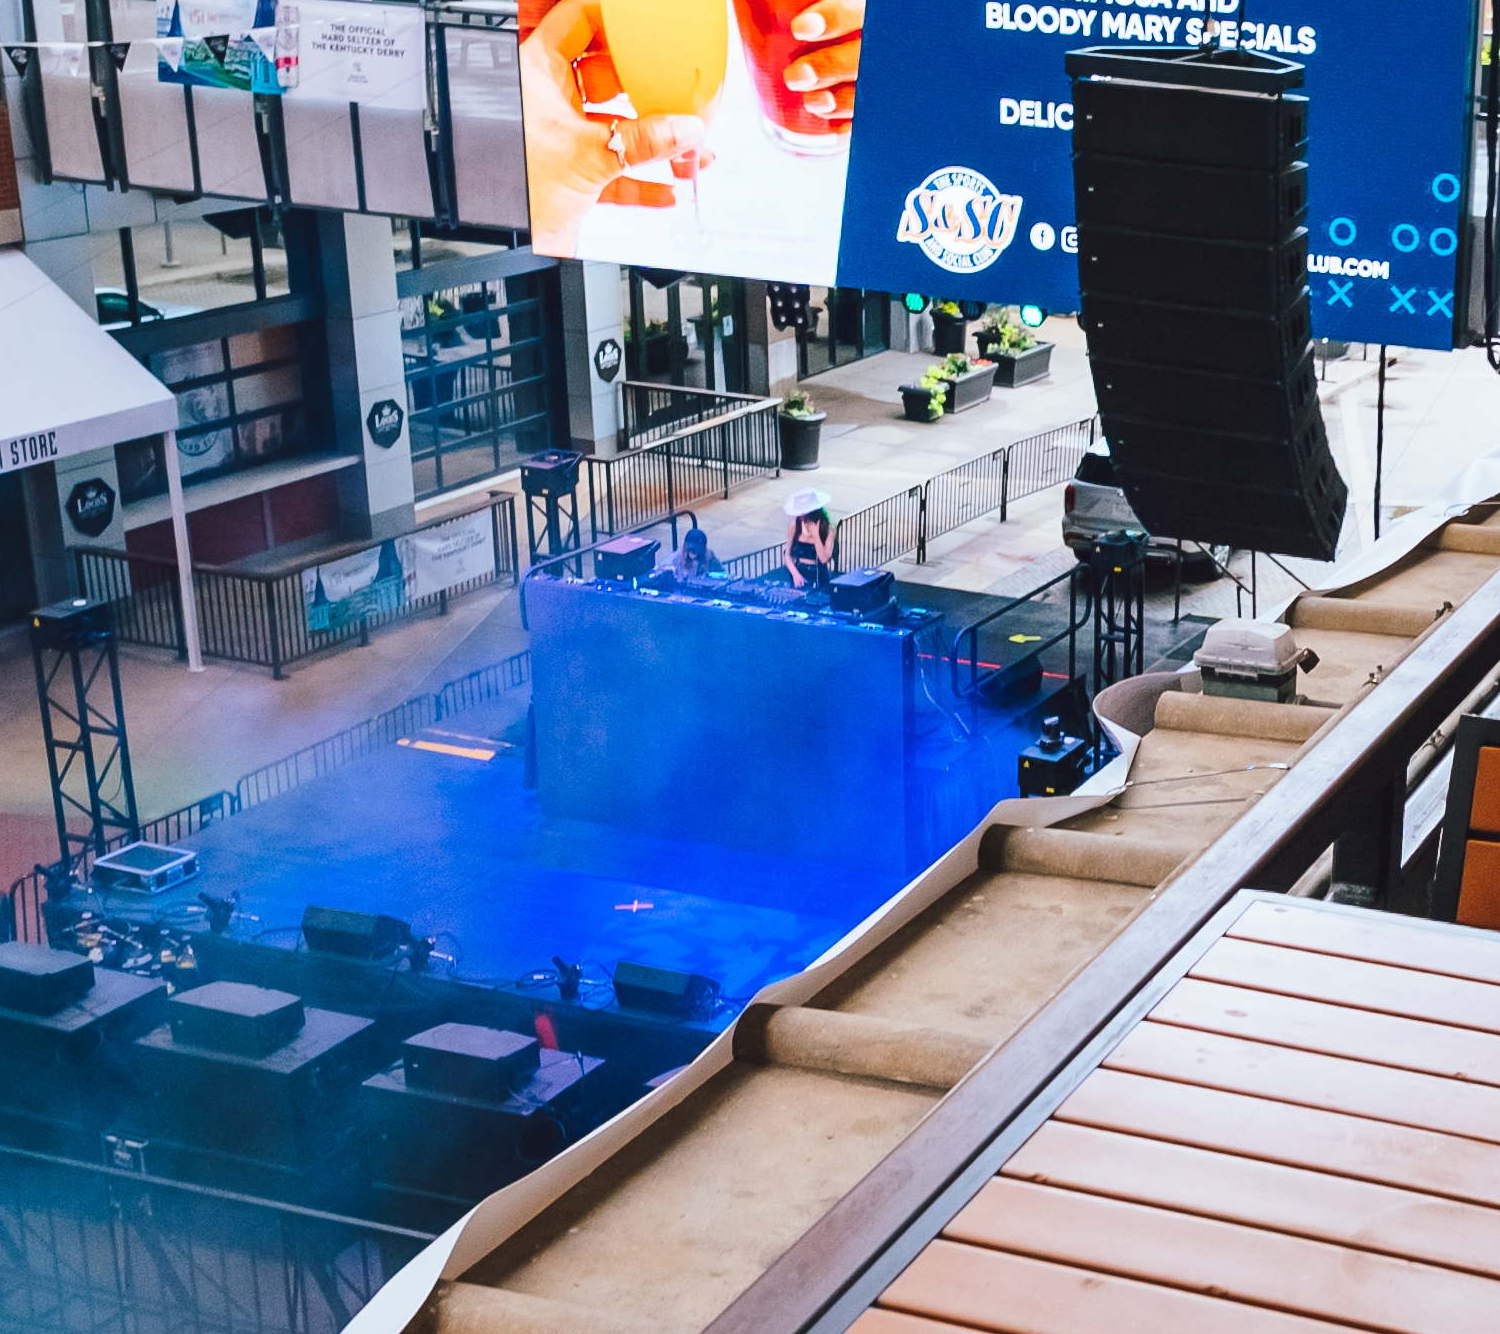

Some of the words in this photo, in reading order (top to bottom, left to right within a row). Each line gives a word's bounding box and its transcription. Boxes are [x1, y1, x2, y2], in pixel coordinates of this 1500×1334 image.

[321, 33, 345, 43] HARD
[347, 34, 382, 46] SELTZER
[383, 37, 396, 47] OF
[330, 24, 346, 34] THE
[348, 25, 386, 37] OFFICIAL
[985, 2, 1097, 35] BLOODY
[1102, 9, 1182, 44] MARY
[1185, 18, 1316, 55] SPECIALS
[312, 41, 328, 52] THE
[329, 43, 375, 56] KENTUCKY
[376, 47, 405, 58] DERBY
[999, 98, 1074, 131] DELIC
[1307, 254, 1389, 279] LUB.COM
[10, 431, 58, 466] STORE
